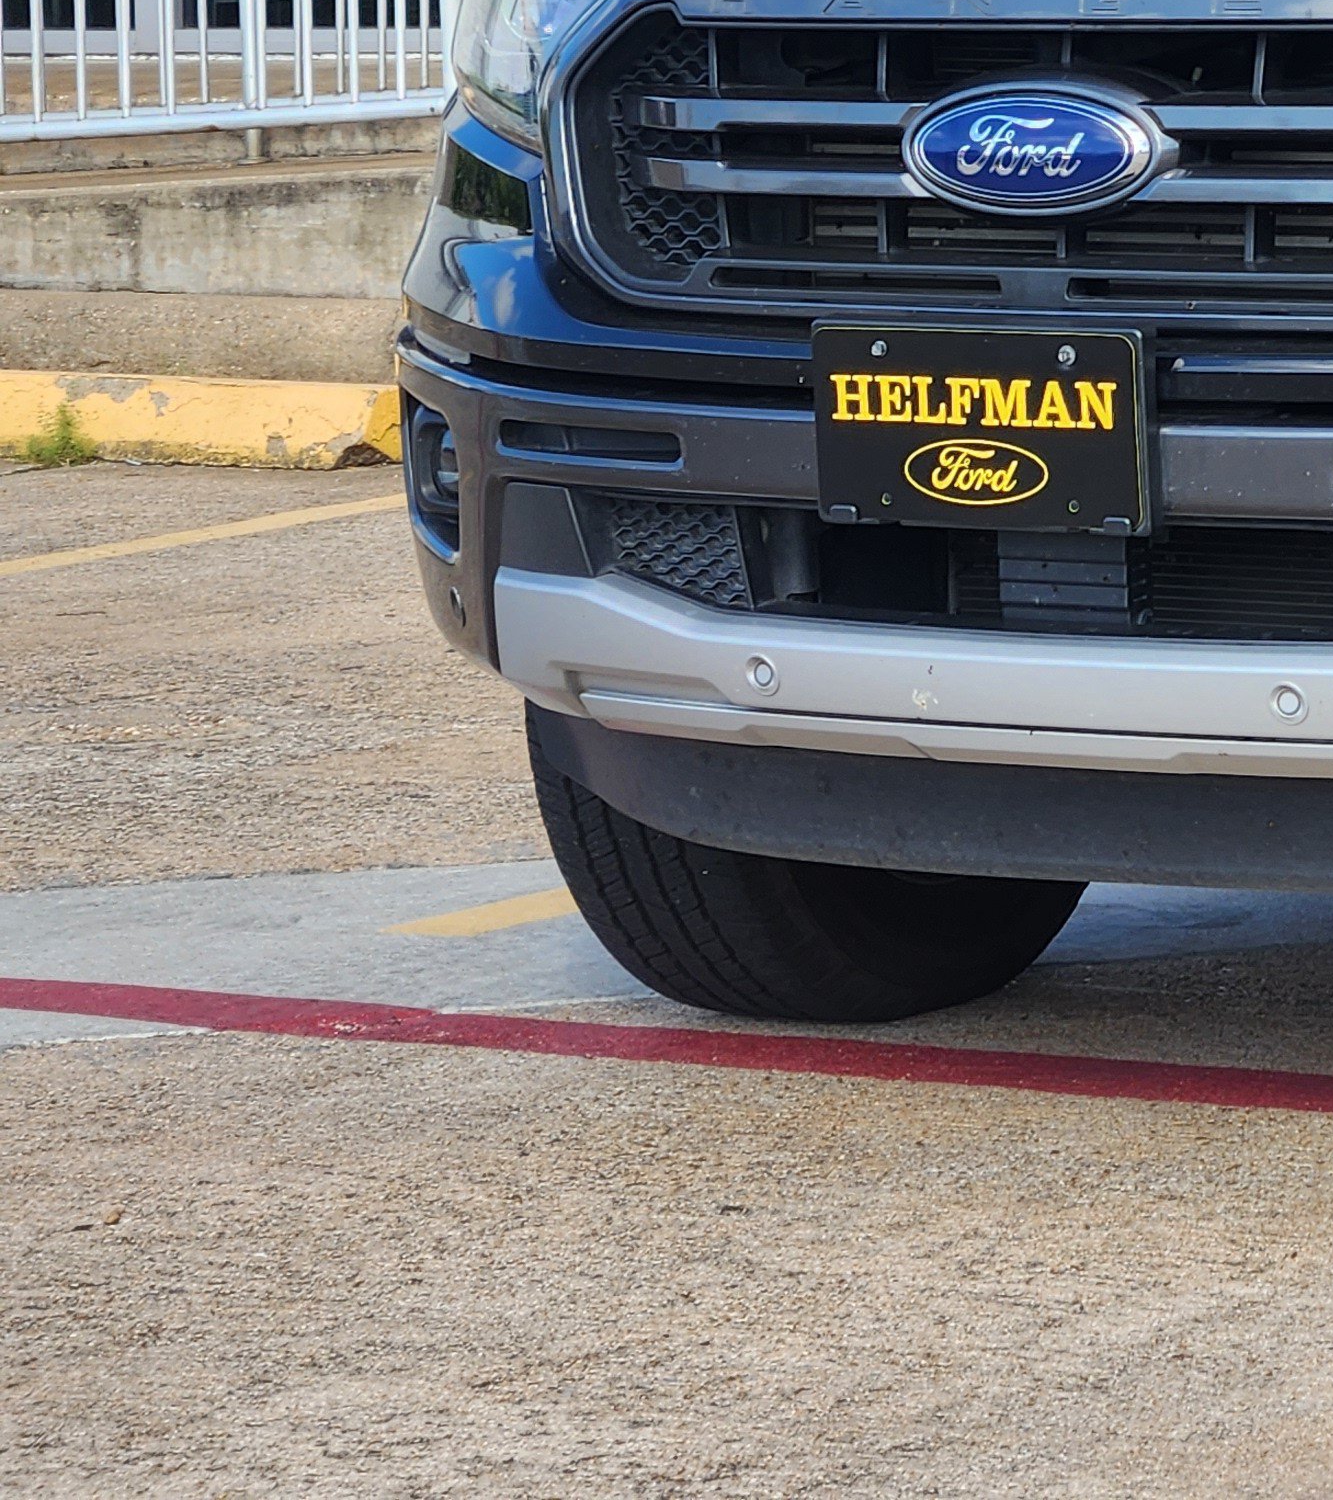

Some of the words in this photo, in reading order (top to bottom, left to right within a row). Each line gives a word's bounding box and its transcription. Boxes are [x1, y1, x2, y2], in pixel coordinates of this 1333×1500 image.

[955, 113, 1085, 178] Ford
[828, 373, 1118, 431] HELFMAN
[930, 446, 1019, 493] Ford
